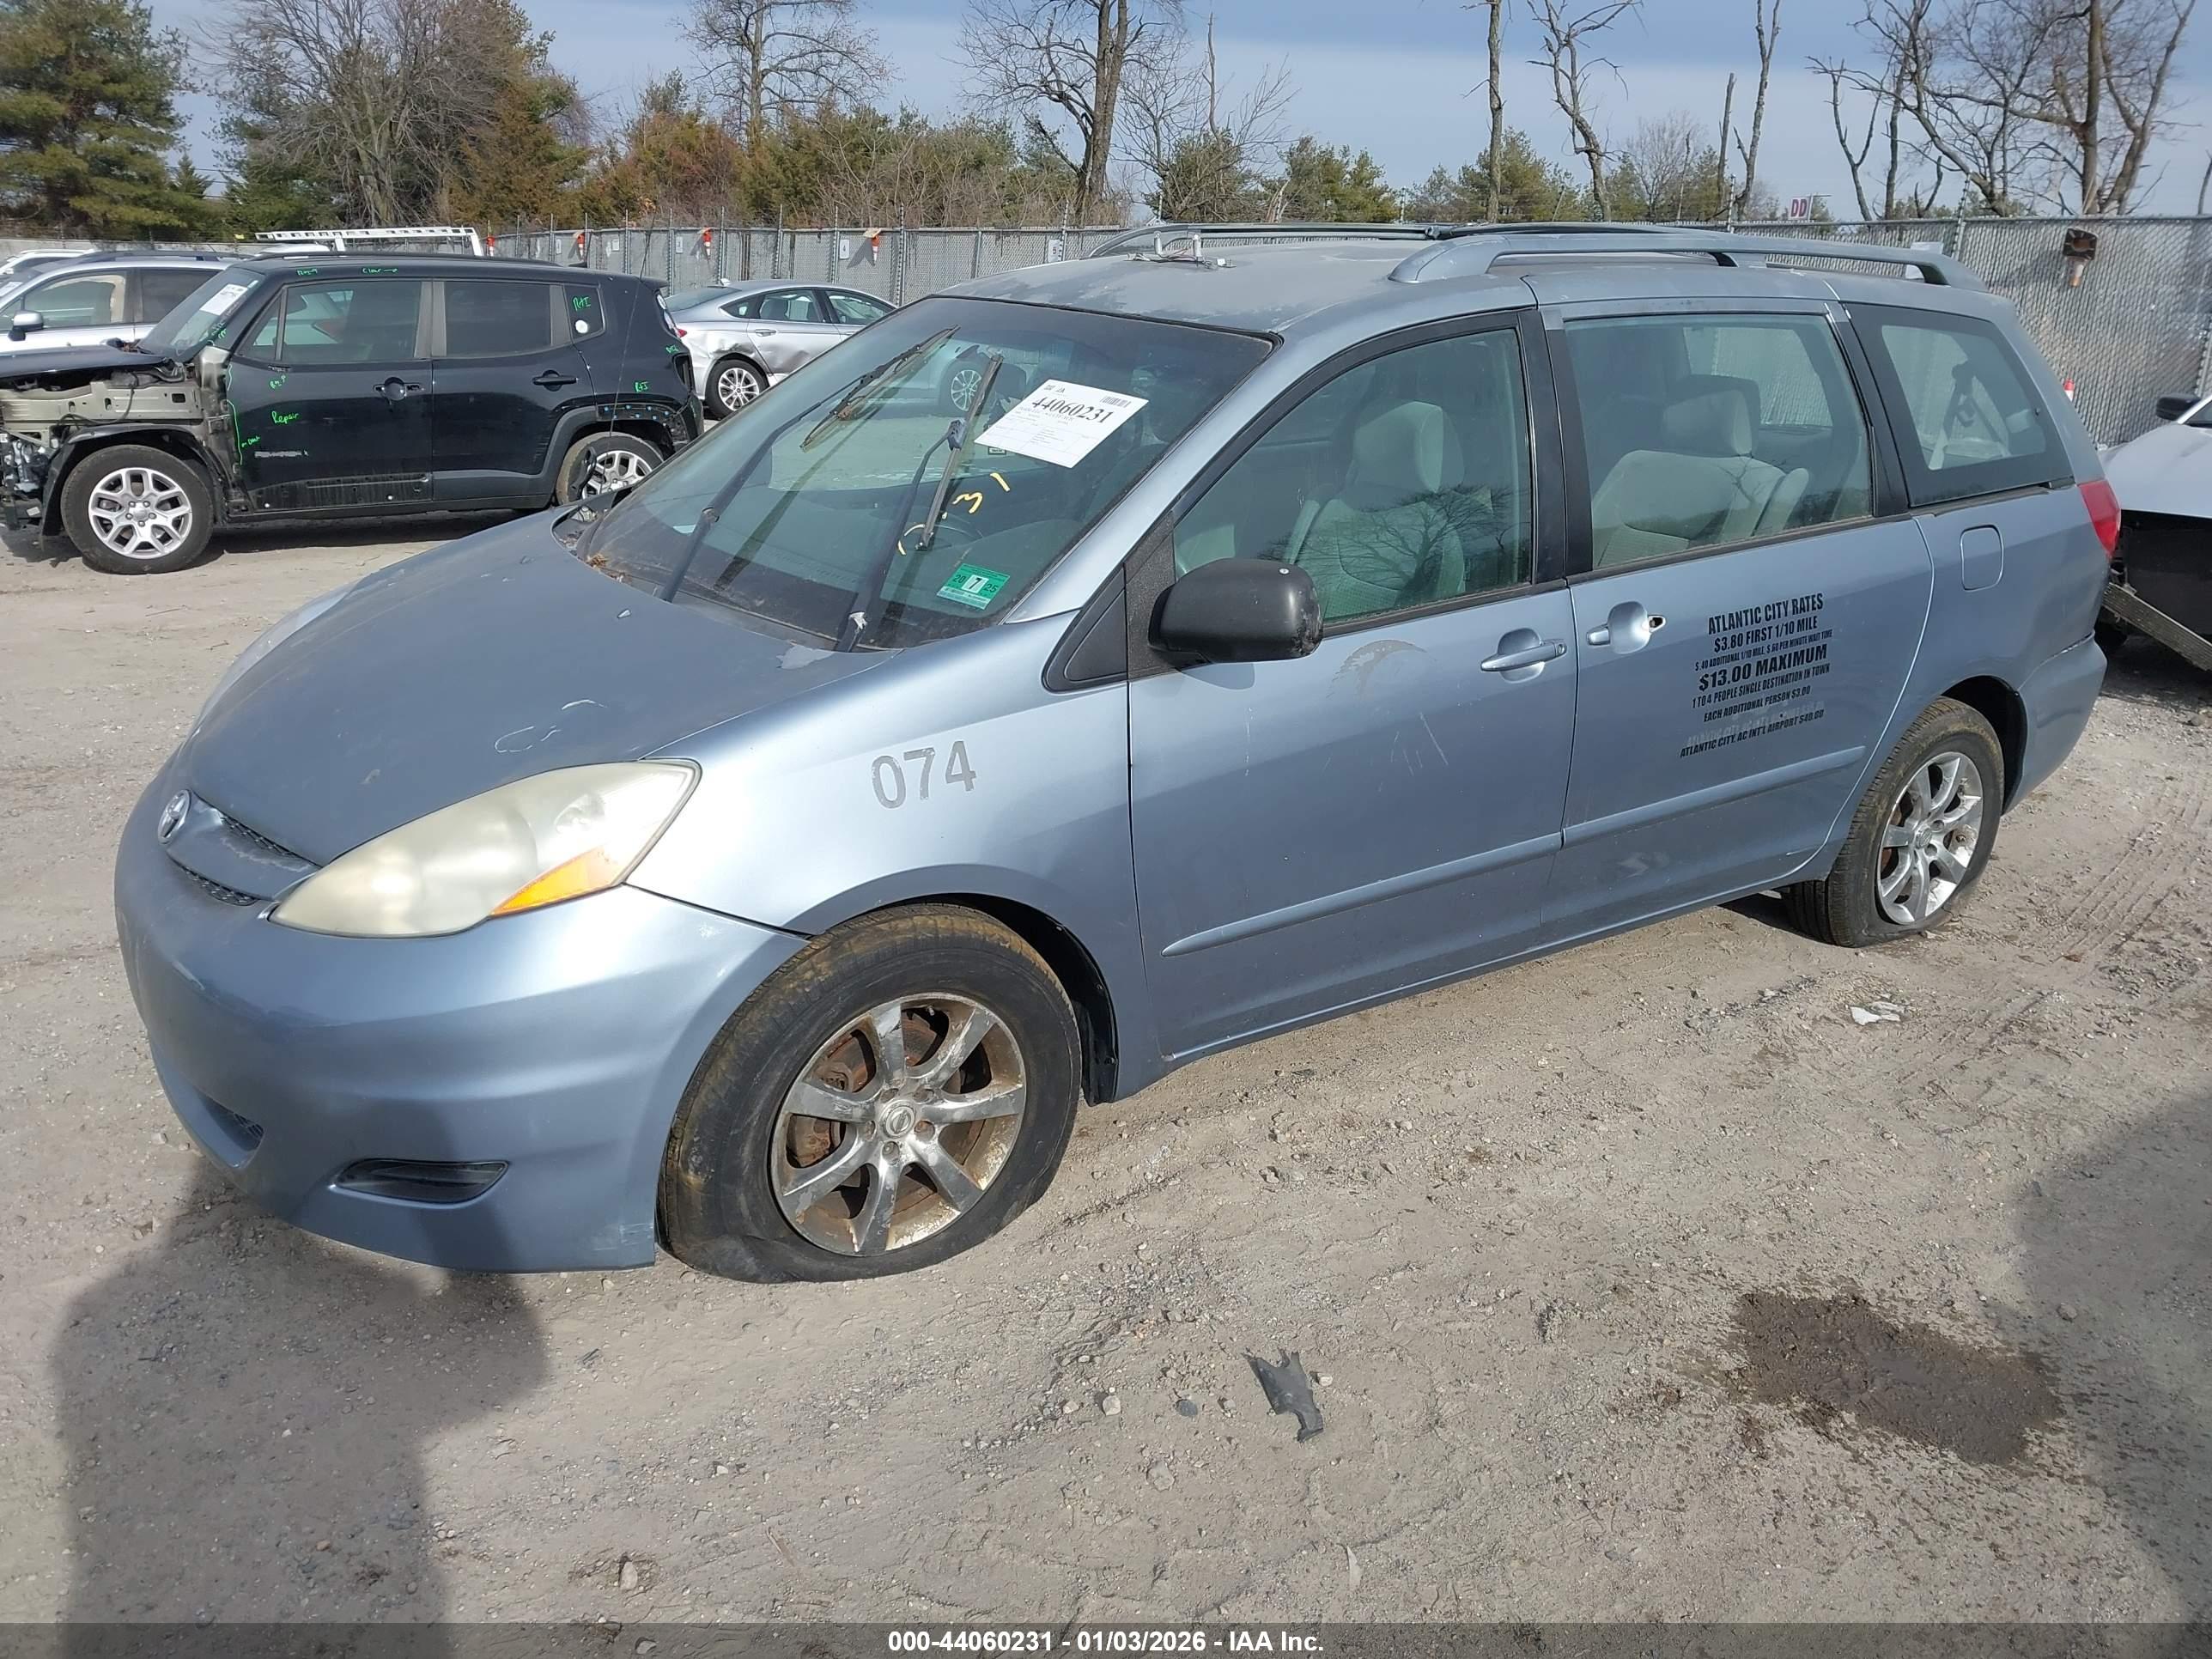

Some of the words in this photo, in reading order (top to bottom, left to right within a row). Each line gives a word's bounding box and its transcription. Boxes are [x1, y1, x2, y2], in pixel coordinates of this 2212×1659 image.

[1790, 198, 1808, 217] DD
[1032, 397, 1114, 423] 44060231
[952, 574, 966, 583] 20
[969, 577, 982, 589] 7
[984, 583, 999, 592] 25
[1708, 606, 1761, 635] ATLANTIC
[1765, 600, 1789, 622] CITY
[1791, 592, 1823, 615] RATES
[1714, 633, 1743, 653] $3.80
[1746, 625, 1773, 645] FIRST
[1775, 621, 1795, 638] 1/10
[1796, 616, 1818, 632] MILE
[1698, 663, 1752, 692] $13.00
[1755, 643, 1827, 677] MAXIMUM
[1709, 653, 1740, 668] ADDITIONAL
[1779, 641, 1789, 650] PER
[1692, 698, 1696, 708] 1
[1698, 695, 1706, 708] TO
[1707, 694, 1711, 703] 4
[1713, 687, 1738, 703] PEOPLE
[1738, 680, 1761, 697] SINGLE
[1762, 670, 1802, 690] DESTINATION
[1804, 668, 1811, 679] IN
[1812, 663, 1830, 677] TOWN
[1704, 708, 1723, 722] EACH
[1723, 698, 1763, 718] ADDITIONAL
[1765, 690, 1791, 705] PERSON
[1791, 684, 1811, 699] $3.00
[1680, 739, 1717, 758] ATLANTIC
[1737, 730, 1748, 742] AC
[1767, 715, 1799, 733] AIRPORT
[1799, 708, 1825, 724] $40.00
[872, 740, 976, 809] 074
